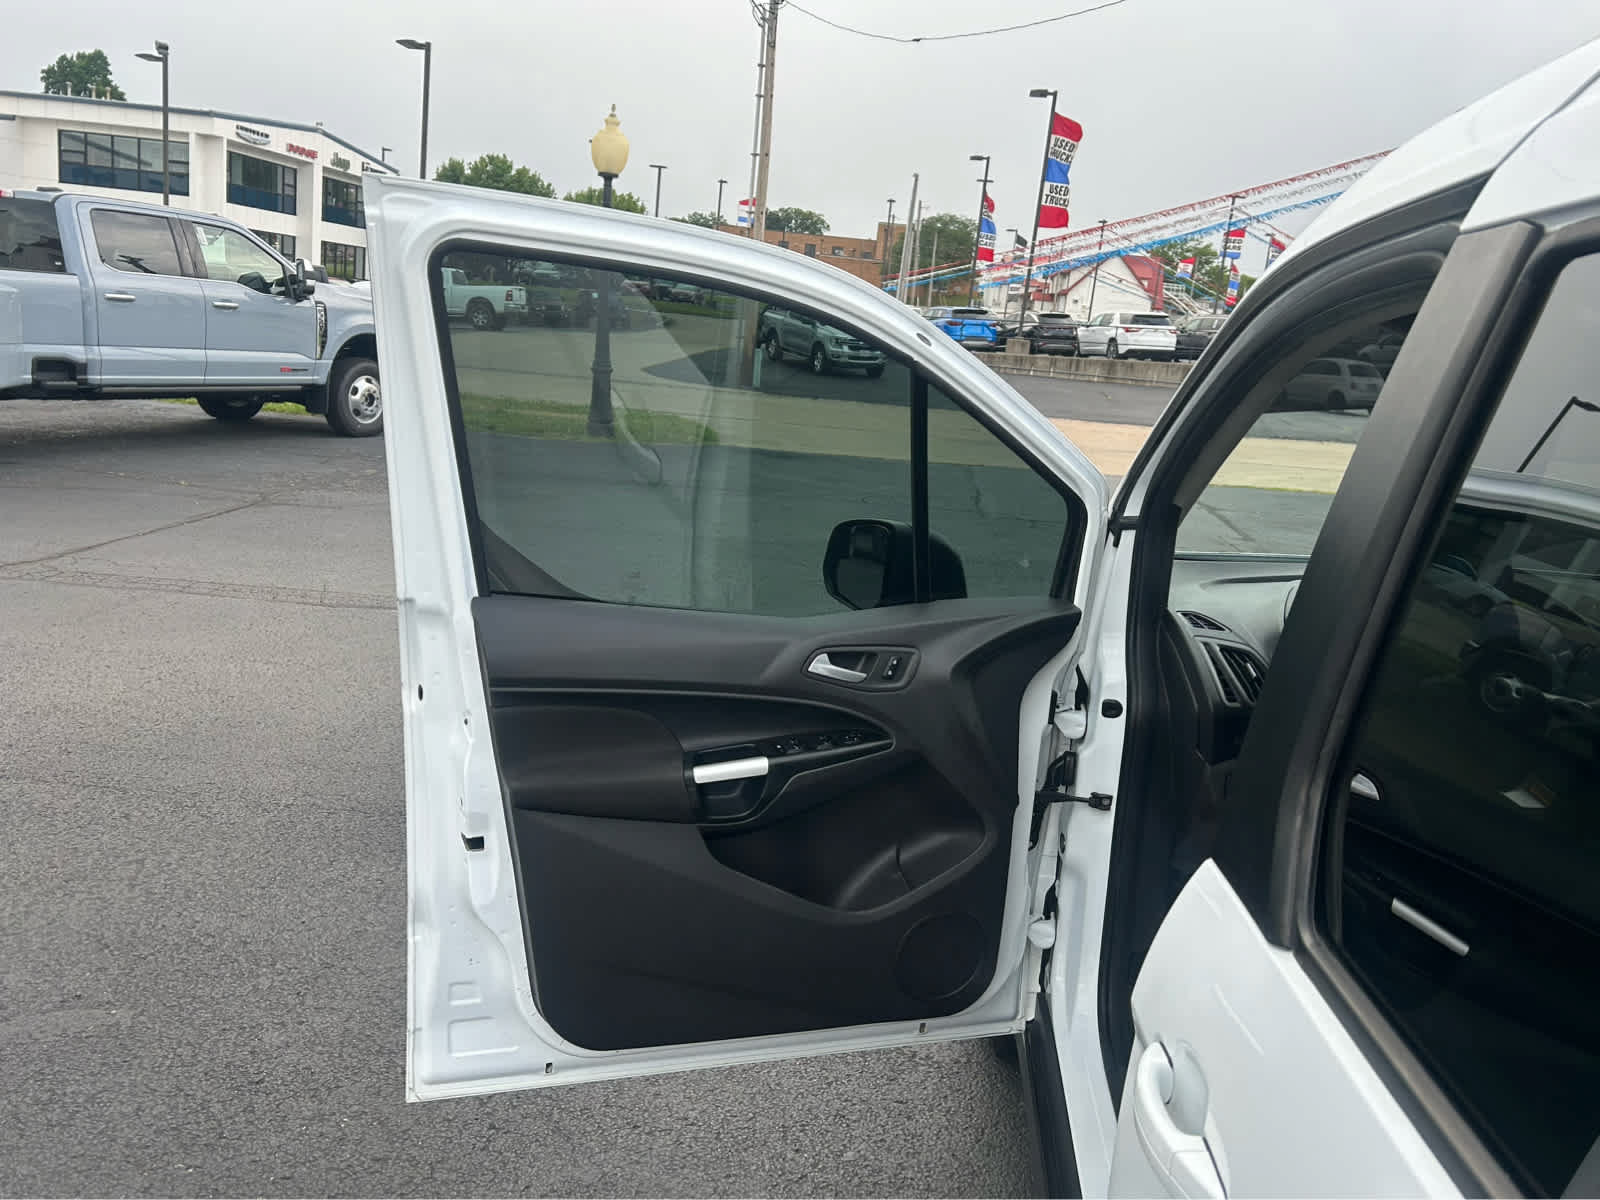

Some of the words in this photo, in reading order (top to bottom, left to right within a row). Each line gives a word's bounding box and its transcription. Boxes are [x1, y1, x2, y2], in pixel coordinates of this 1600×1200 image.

[287, 143, 318, 160] DODGE
[1053, 136, 1076, 153] USED
[1049, 184, 1070, 197] USED
